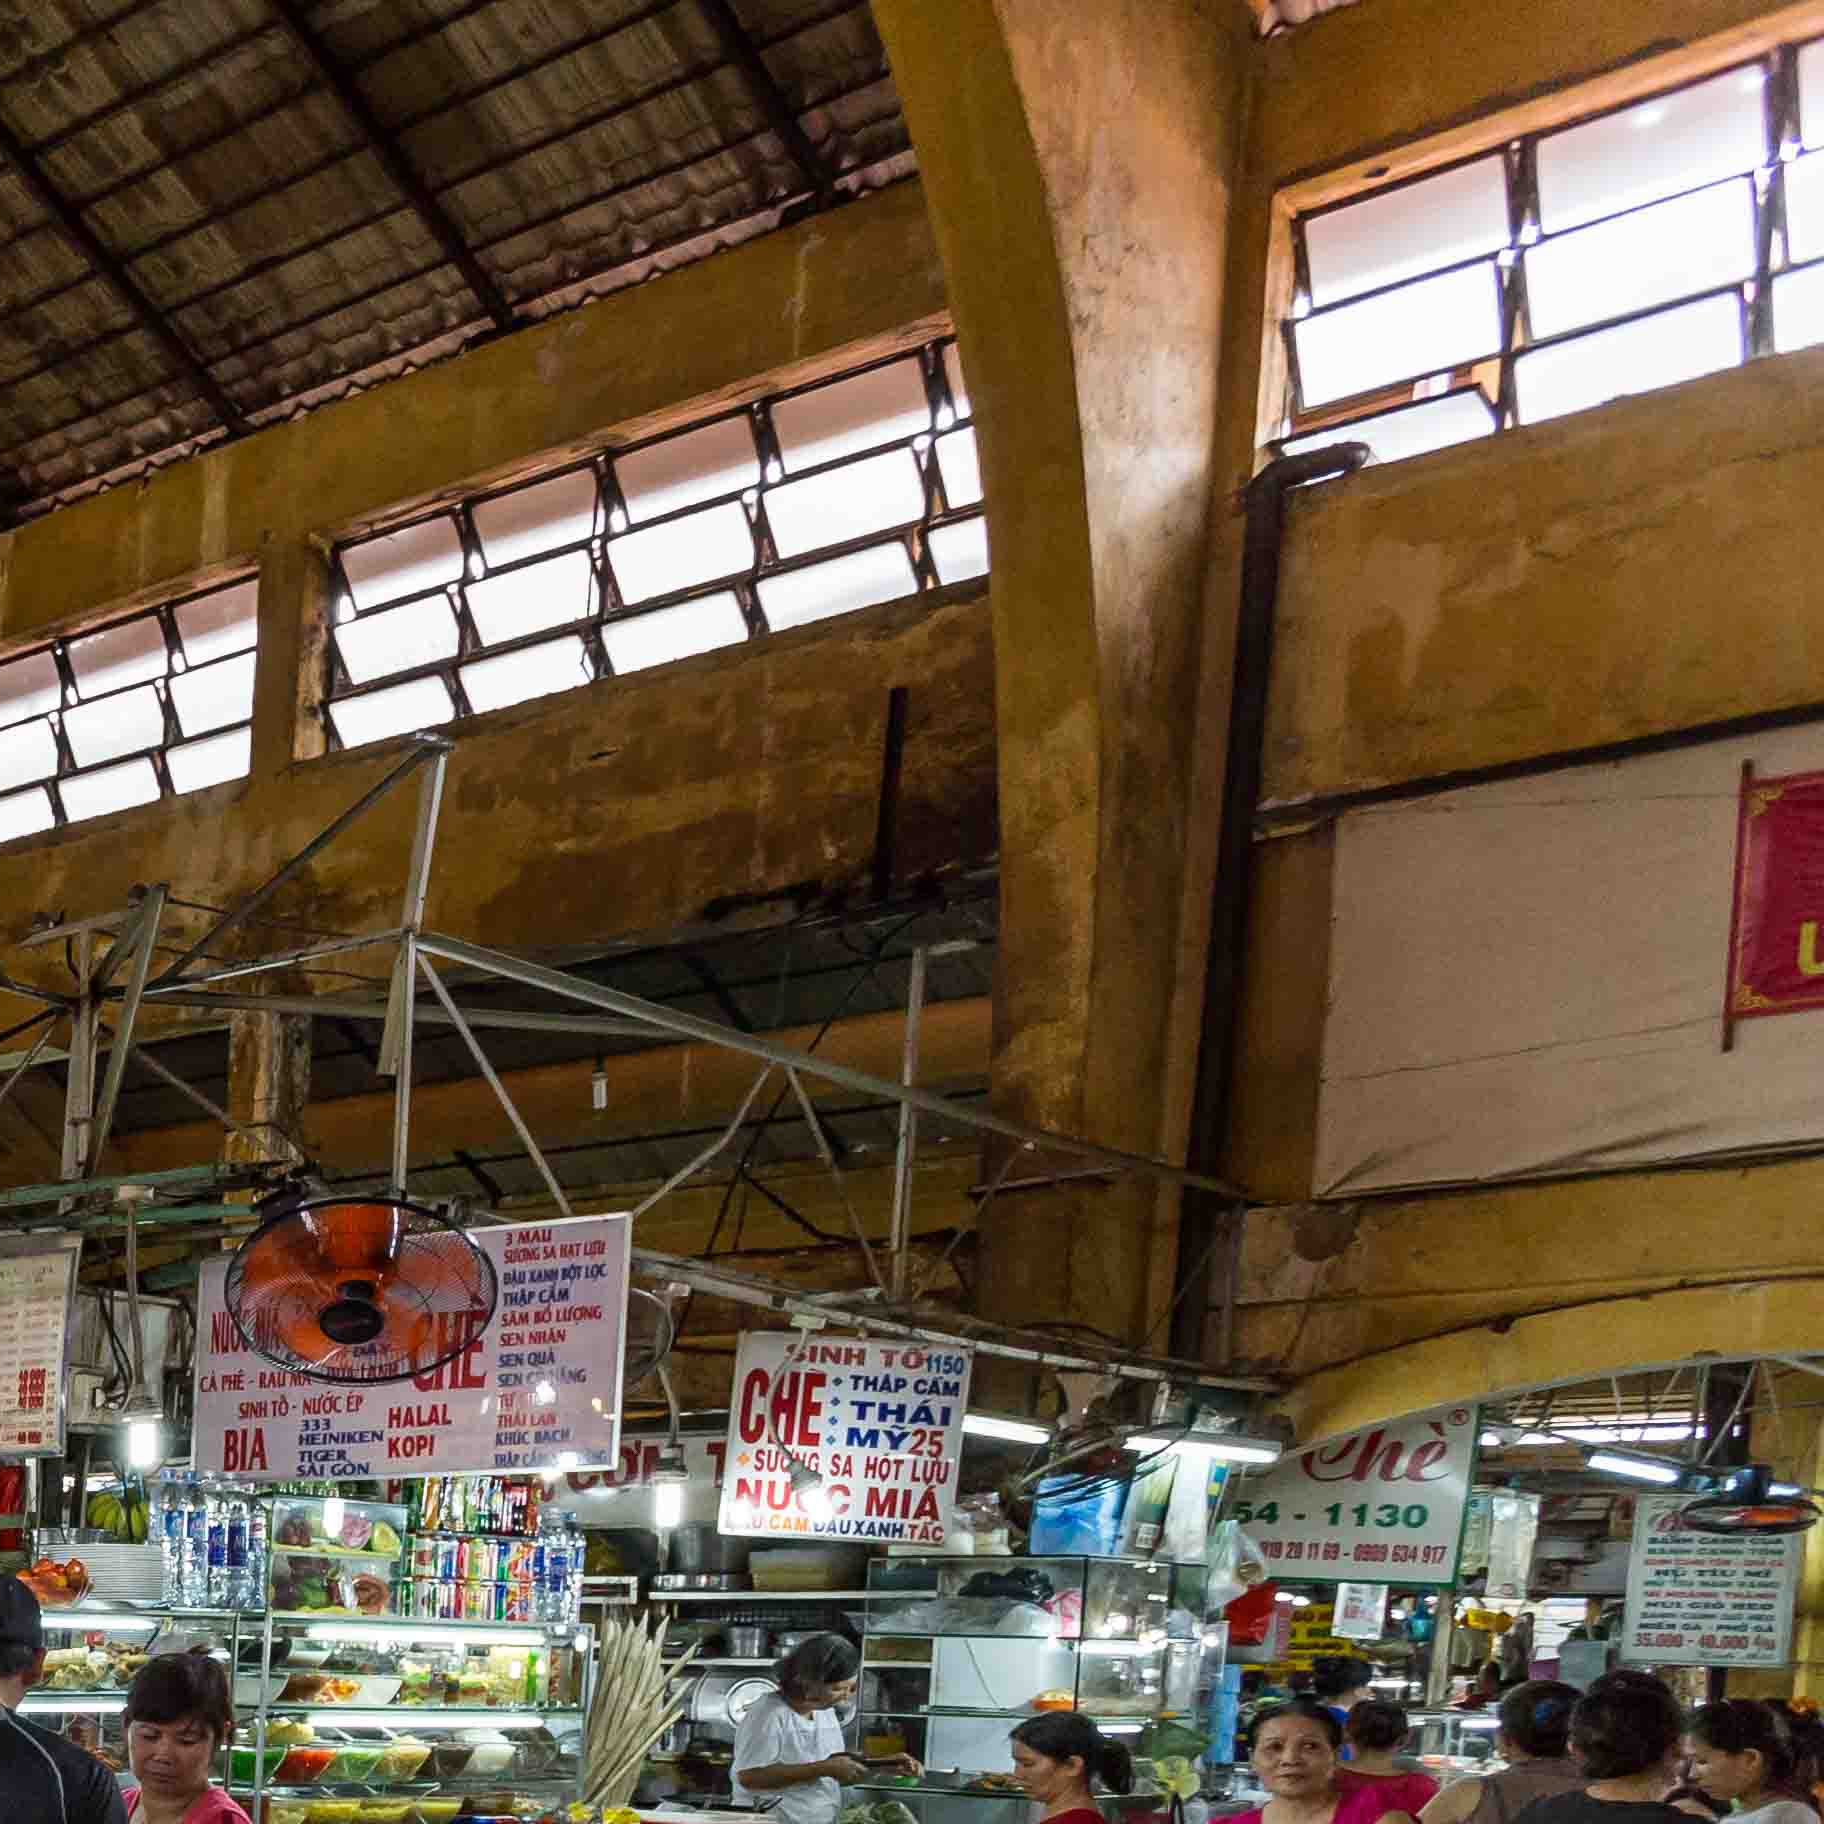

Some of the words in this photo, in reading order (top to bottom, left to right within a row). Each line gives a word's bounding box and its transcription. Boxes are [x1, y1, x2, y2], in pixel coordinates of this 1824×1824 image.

[505, 1232, 512, 1245] 3
[500, 1332, 524, 1347] SEN
[498, 1353, 524, 1367] SEN
[785, 1344, 866, 1366] SINH
[927, 1352, 964, 1375] 1150
[200, 1370, 218, 1392] CÀ
[259, 1371, 286, 1389] RAU
[239, 1402, 268, 1419] SINH
[388, 1403, 453, 1428] HALAL
[739, 1367, 827, 1447] CHÈ
[850, 1399, 951, 1426] THÁI
[301, 1418, 331, 1432] 333
[224, 1428, 268, 1472] BIA
[298, 1431, 384, 1446] HEINIKEN
[388, 1434, 435, 1458] KOPI
[846, 1425, 911, 1450] MỸ
[909, 1429, 944, 1457] 25
[299, 1449, 347, 1464] TIGER
[1303, 1421, 1449, 1482] Chè
[830, 1454, 852, 1478] SA
[1325, 1503, 1429, 1528] 1130
